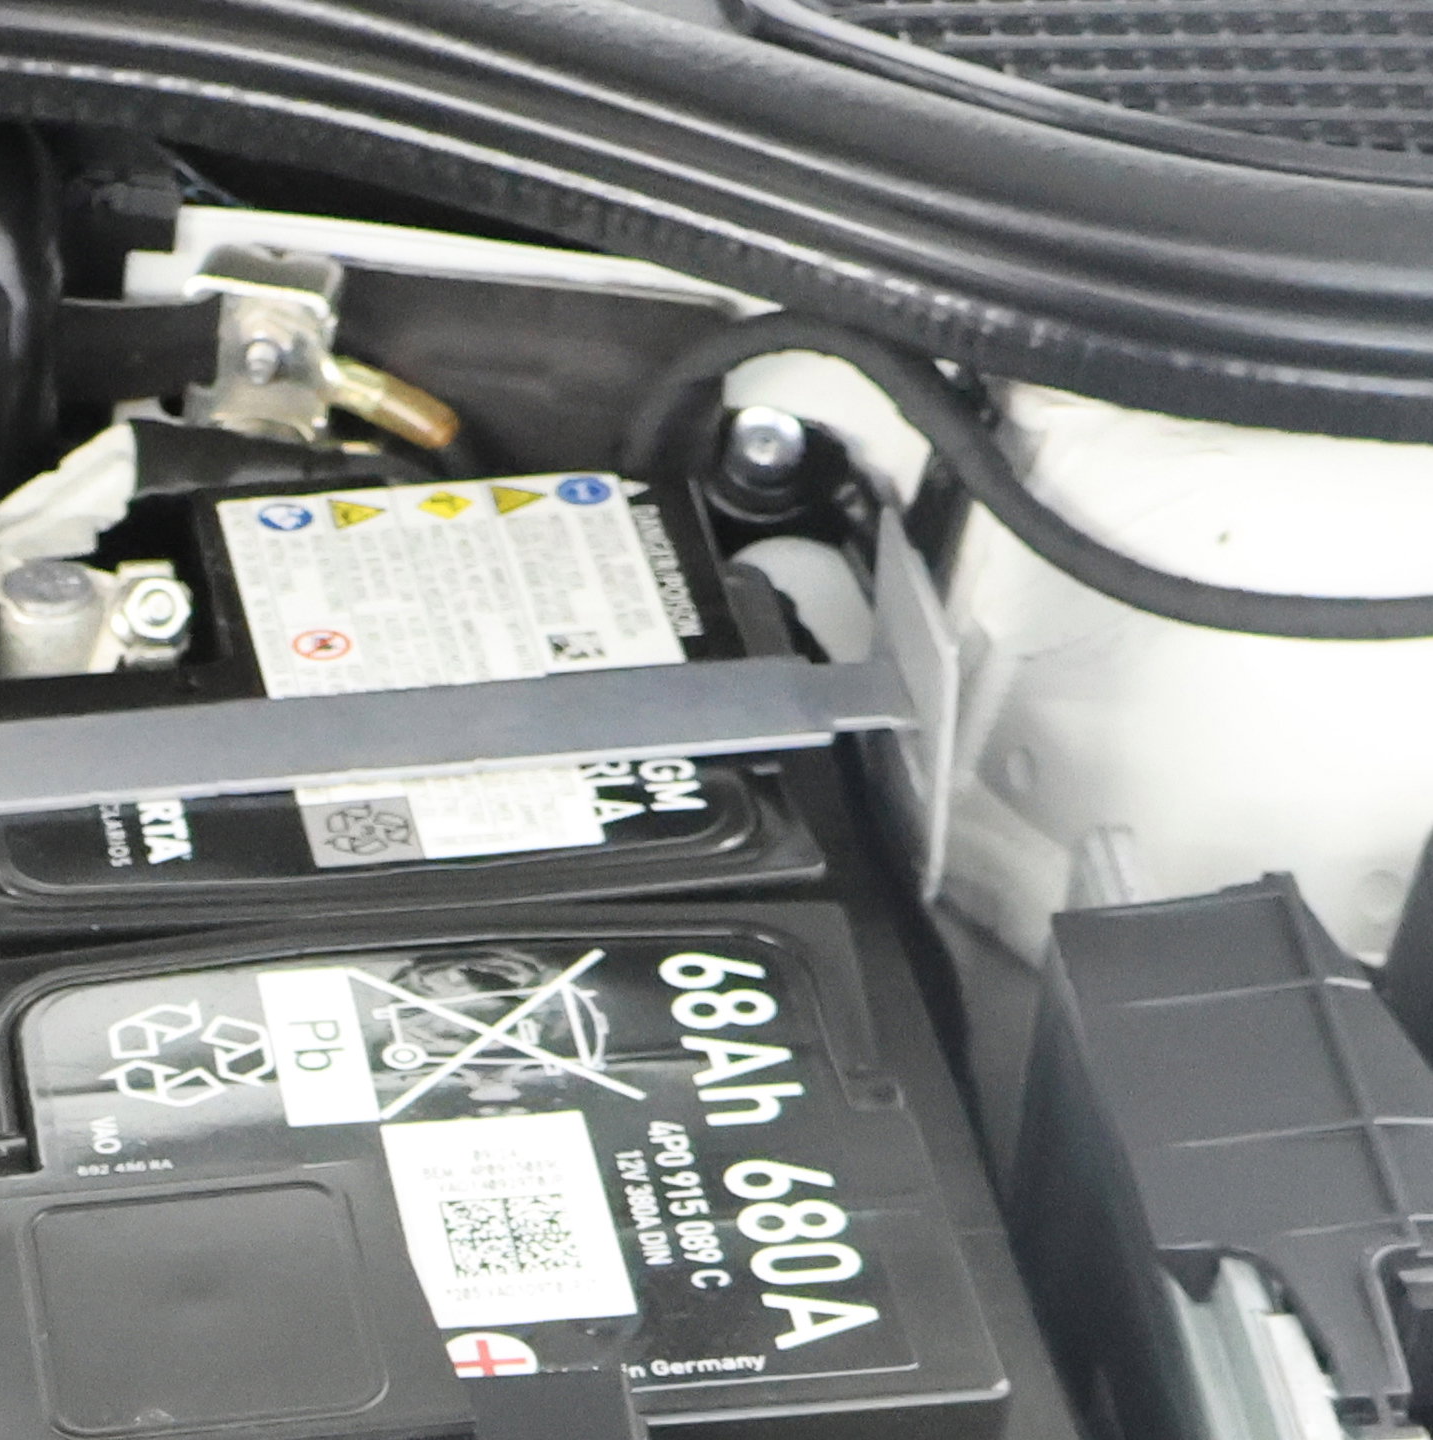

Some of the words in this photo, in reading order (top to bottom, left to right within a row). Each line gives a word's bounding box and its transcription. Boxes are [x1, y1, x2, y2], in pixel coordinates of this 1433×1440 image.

[639, 758, 708, 812] GM
[137, 799, 192, 864] RTA
[288, 1020, 345, 1071] Pb
[658, 951, 805, 1127] 68Ah
[660, 1171, 710, 1216] 915
[638, 1231, 675, 1265] DIN
[675, 1220, 724, 1263] 089
[723, 1159, 881, 1350] 680A
[690, 1269, 732, 1289] C
[650, 1355, 766, 1376] Germany
